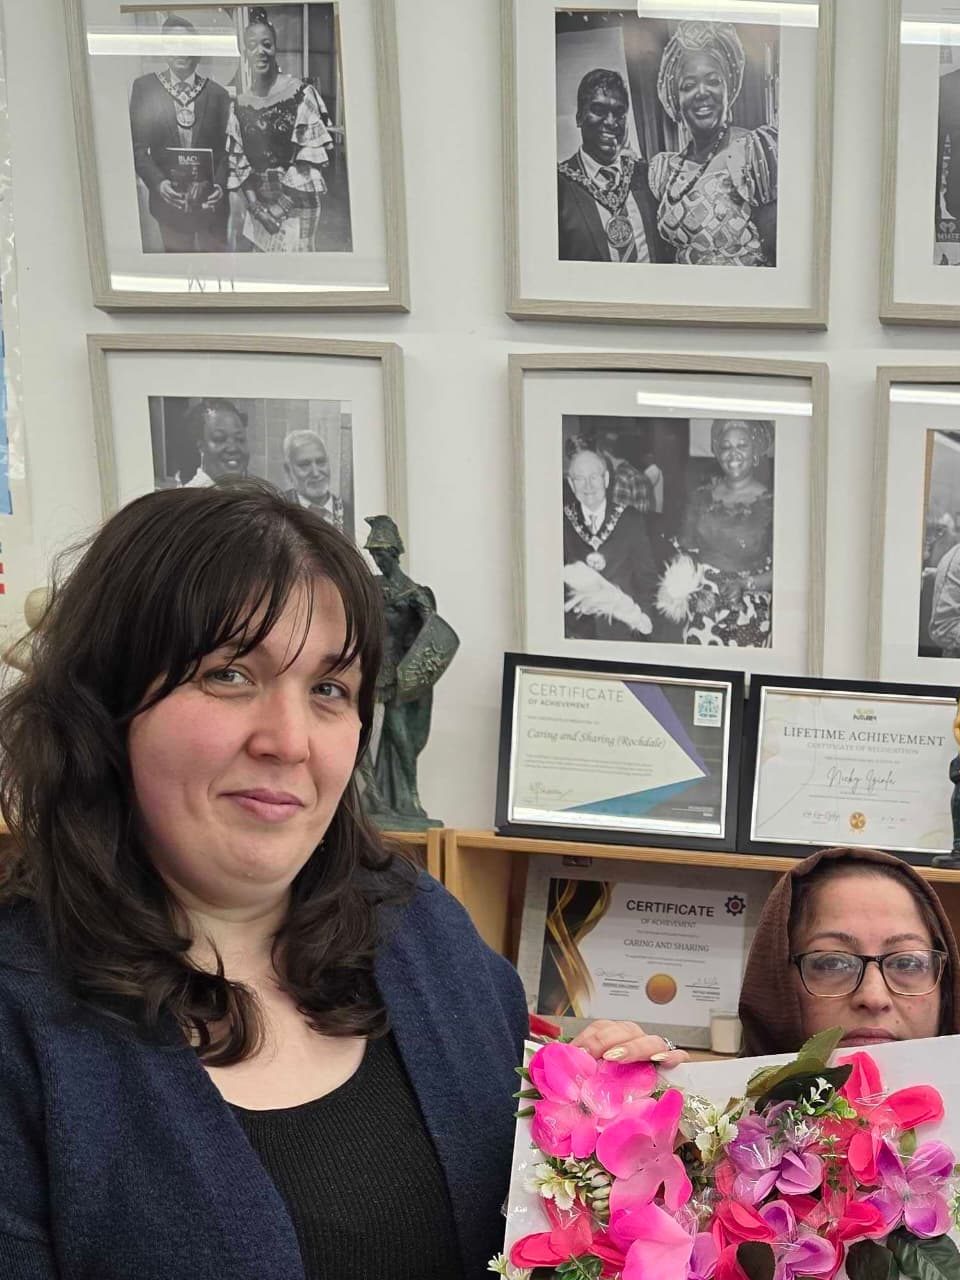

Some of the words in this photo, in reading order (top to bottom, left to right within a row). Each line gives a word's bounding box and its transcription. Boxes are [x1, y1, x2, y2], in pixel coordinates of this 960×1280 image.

[528, 683, 625, 703] CERTIFICATE
[540, 700, 590, 710] ACHIEVEMENT
[527, 728, 558, 744] Caring
[560, 730, 576, 742] and
[577, 731, 615, 748] Sharing
[783, 726, 846, 741] LIFETIME
[849, 731, 946, 746] ACHIEVEMENT
[626, 900, 715, 917] CERTIFICATE
[623, 938, 655, 948] CARING
[655, 941, 673, 949] AND
[674, 942, 710, 952] SHARING
